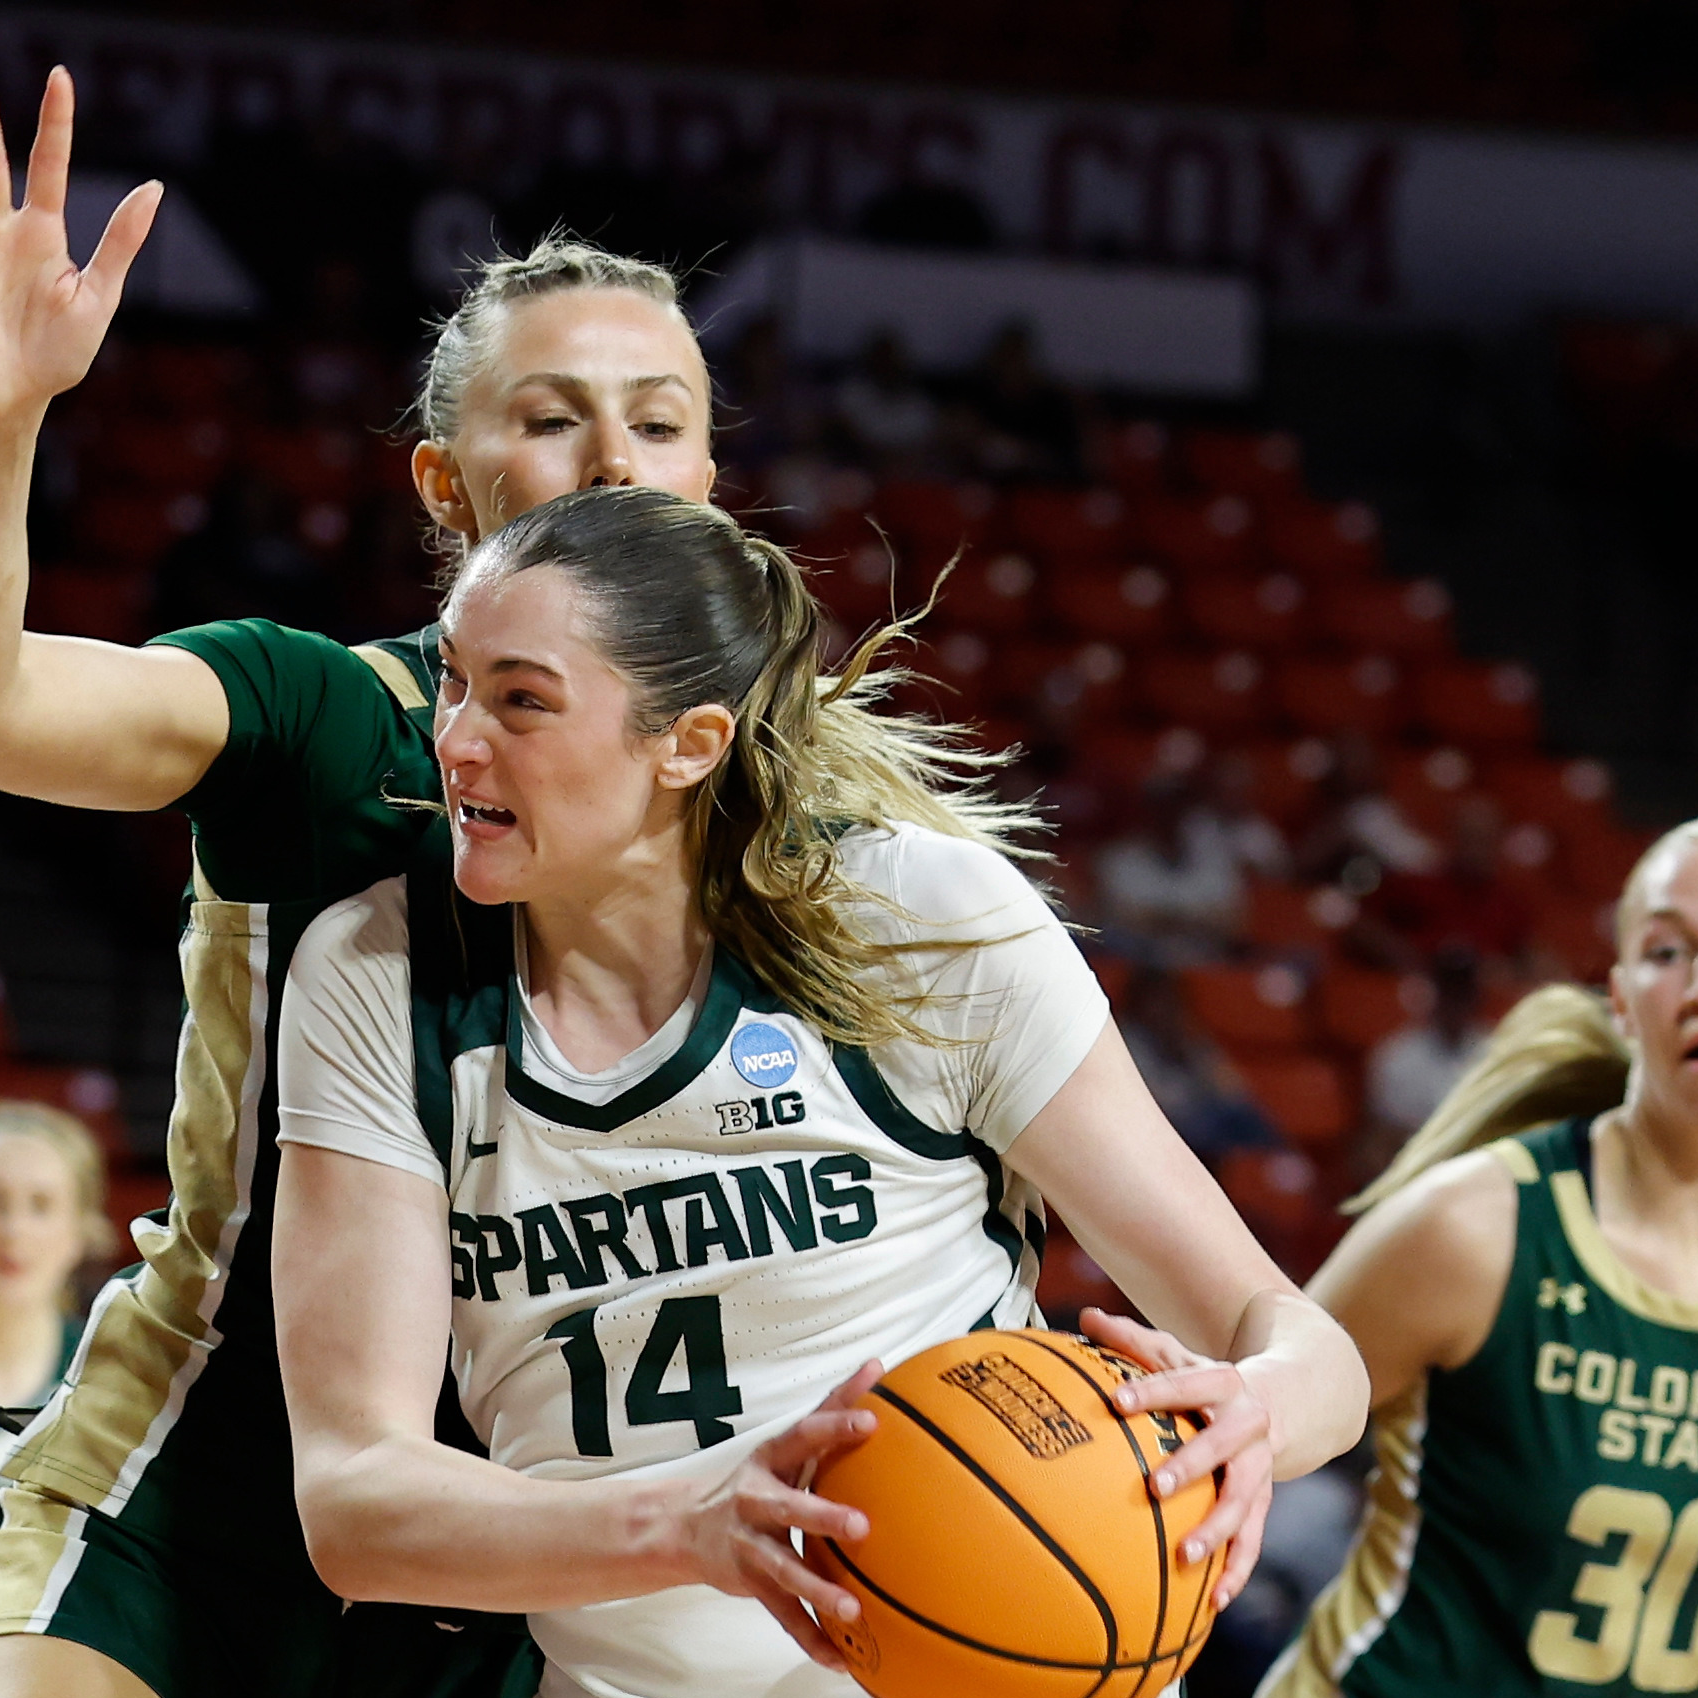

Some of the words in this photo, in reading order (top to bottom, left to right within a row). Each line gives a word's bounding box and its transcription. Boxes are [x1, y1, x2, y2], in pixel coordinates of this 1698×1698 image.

[742, 1050, 796, 1073] NCAA
[450, 1152, 878, 1302] SPARTANS
[543, 1294, 743, 1457] 14
